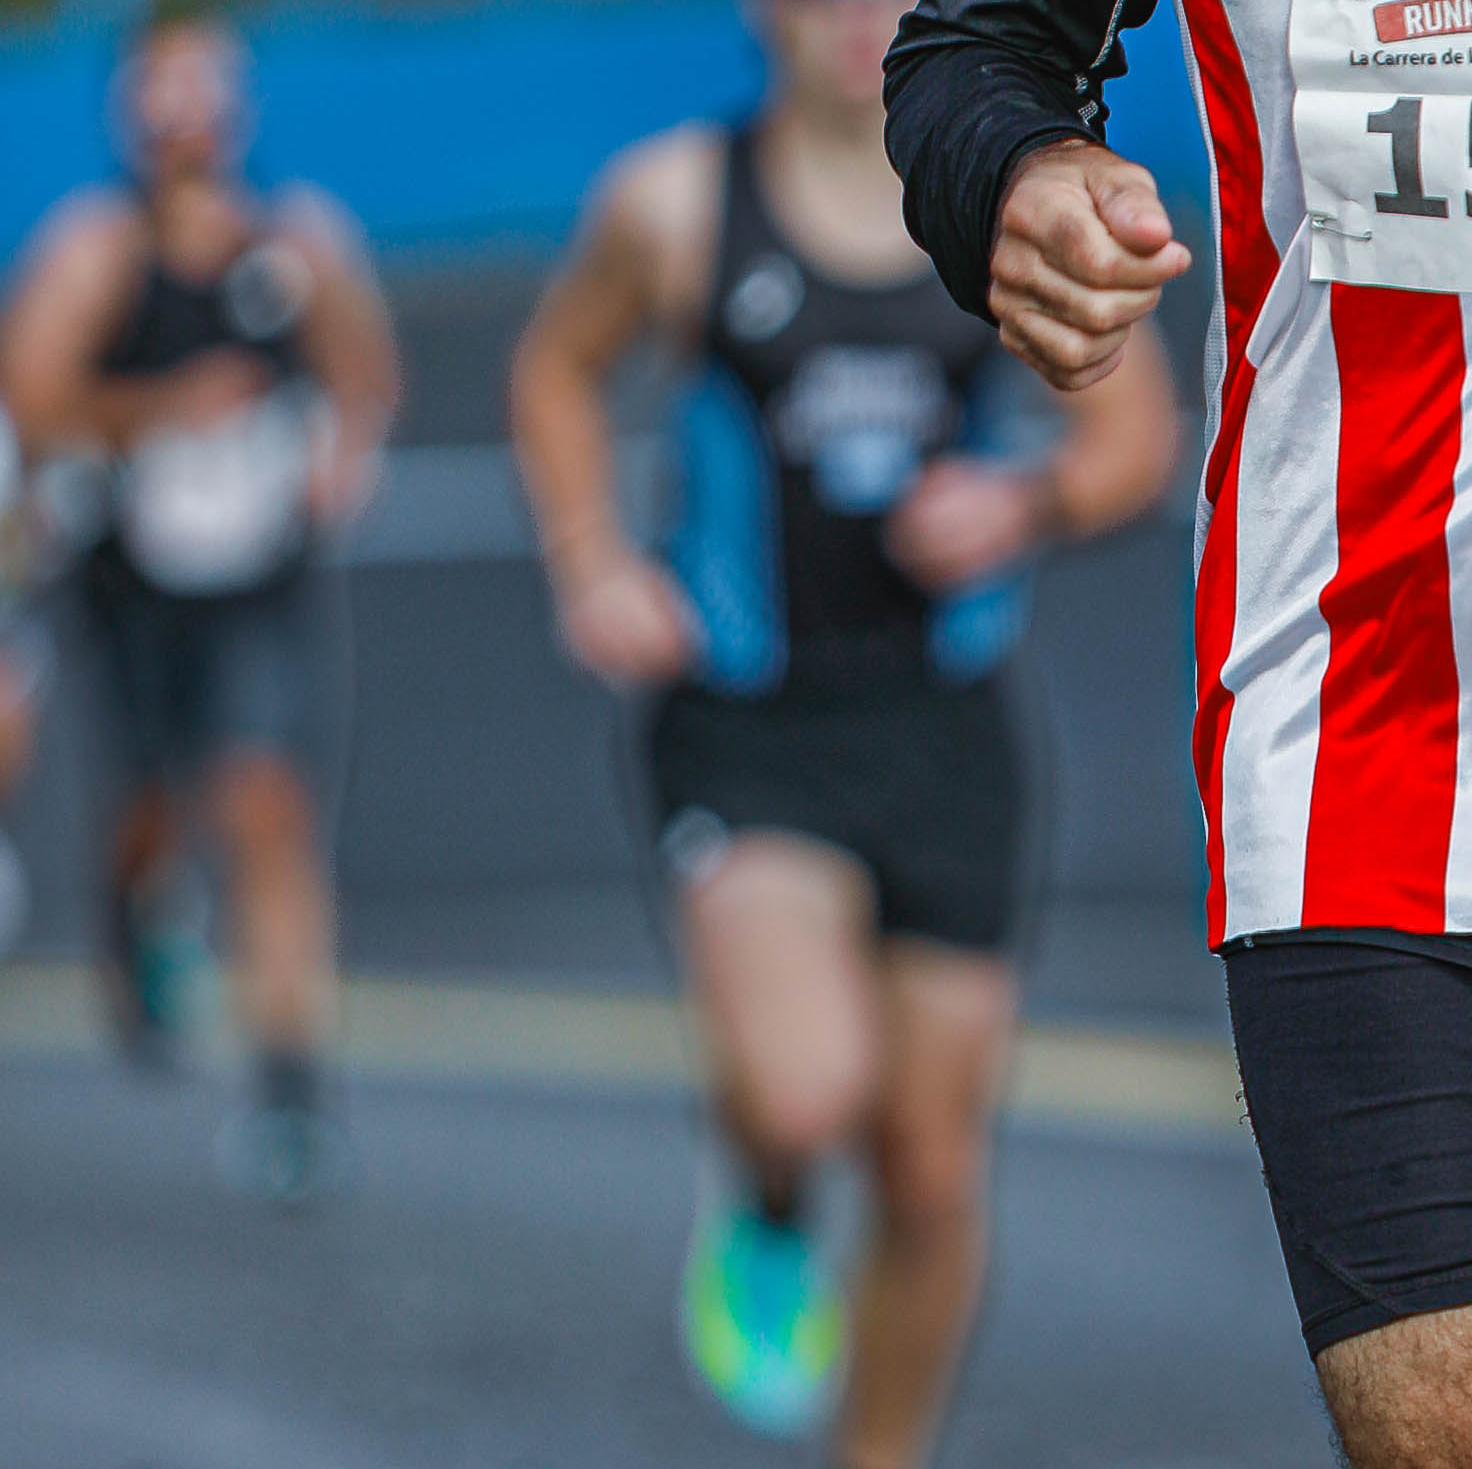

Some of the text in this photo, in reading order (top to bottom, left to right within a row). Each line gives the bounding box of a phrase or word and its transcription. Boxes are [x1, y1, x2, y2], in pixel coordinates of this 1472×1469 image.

[1350, 50, 1369, 66] La
[1372, 50, 1437, 66] Carrera
[1442, 48, 1464, 65] de
